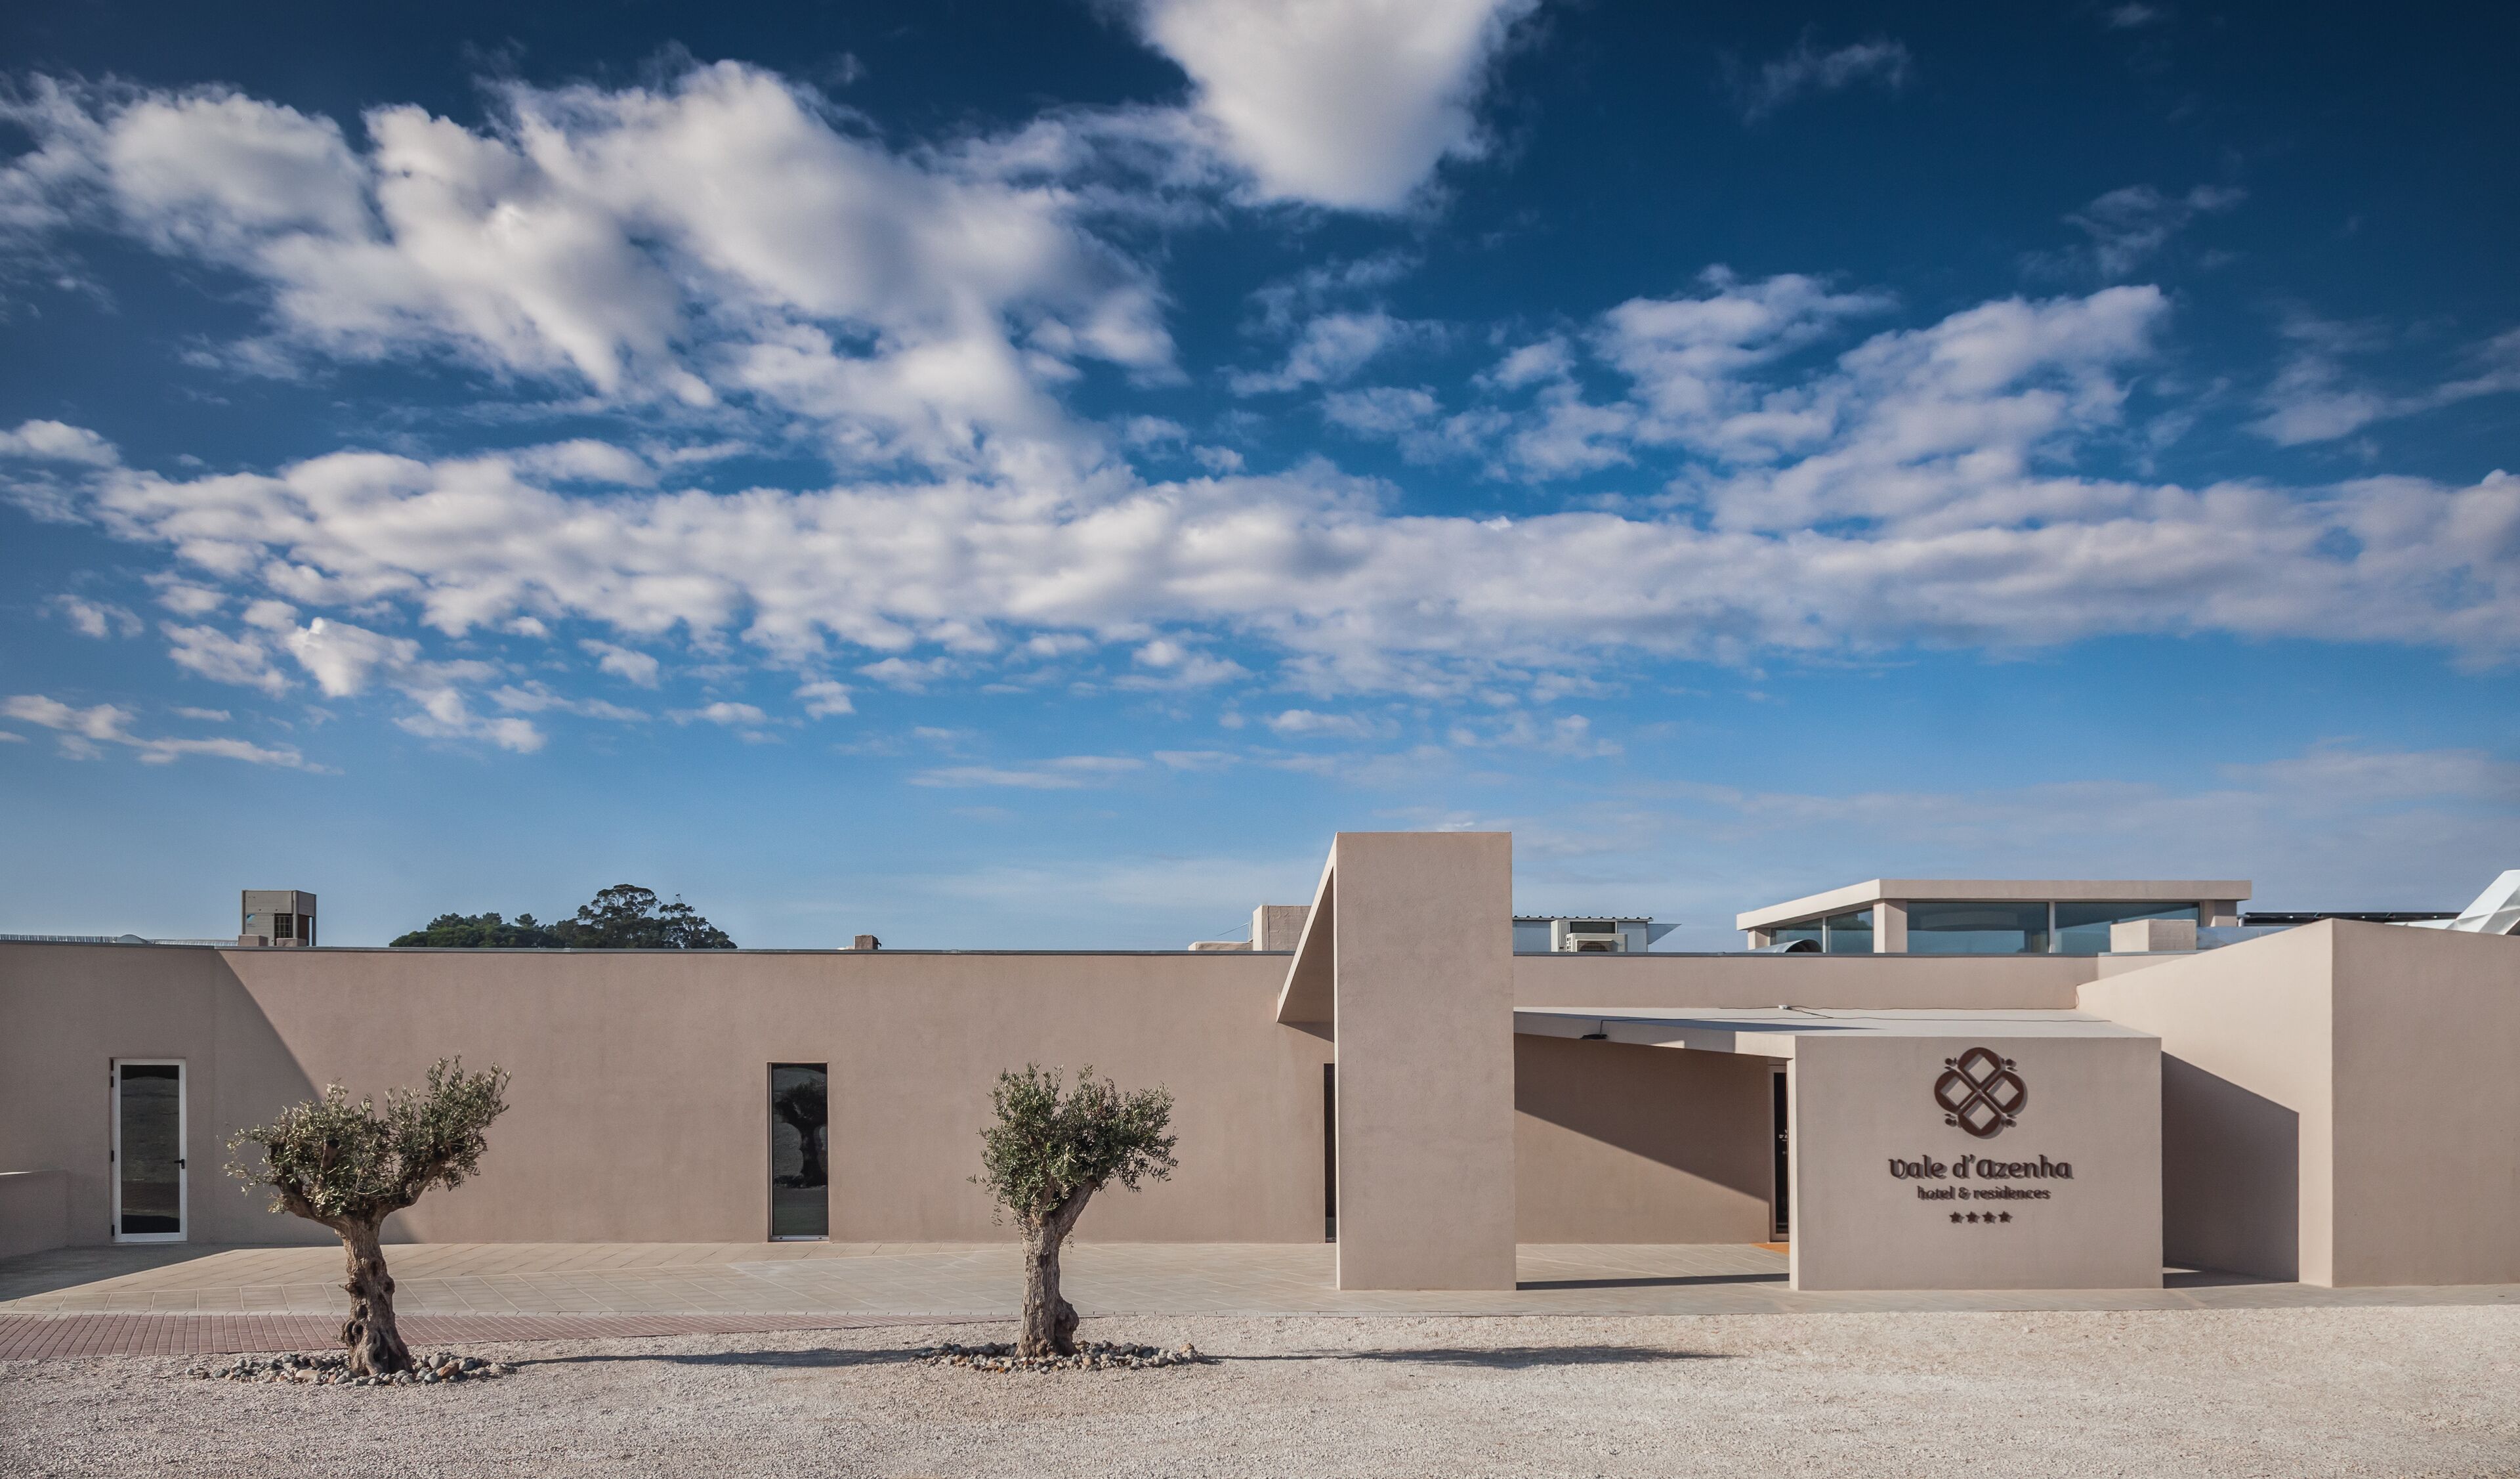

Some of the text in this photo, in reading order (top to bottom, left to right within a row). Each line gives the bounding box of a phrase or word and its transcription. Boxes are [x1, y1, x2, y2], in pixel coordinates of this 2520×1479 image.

[1917, 1186, 2050, 1199] hotel & residences
